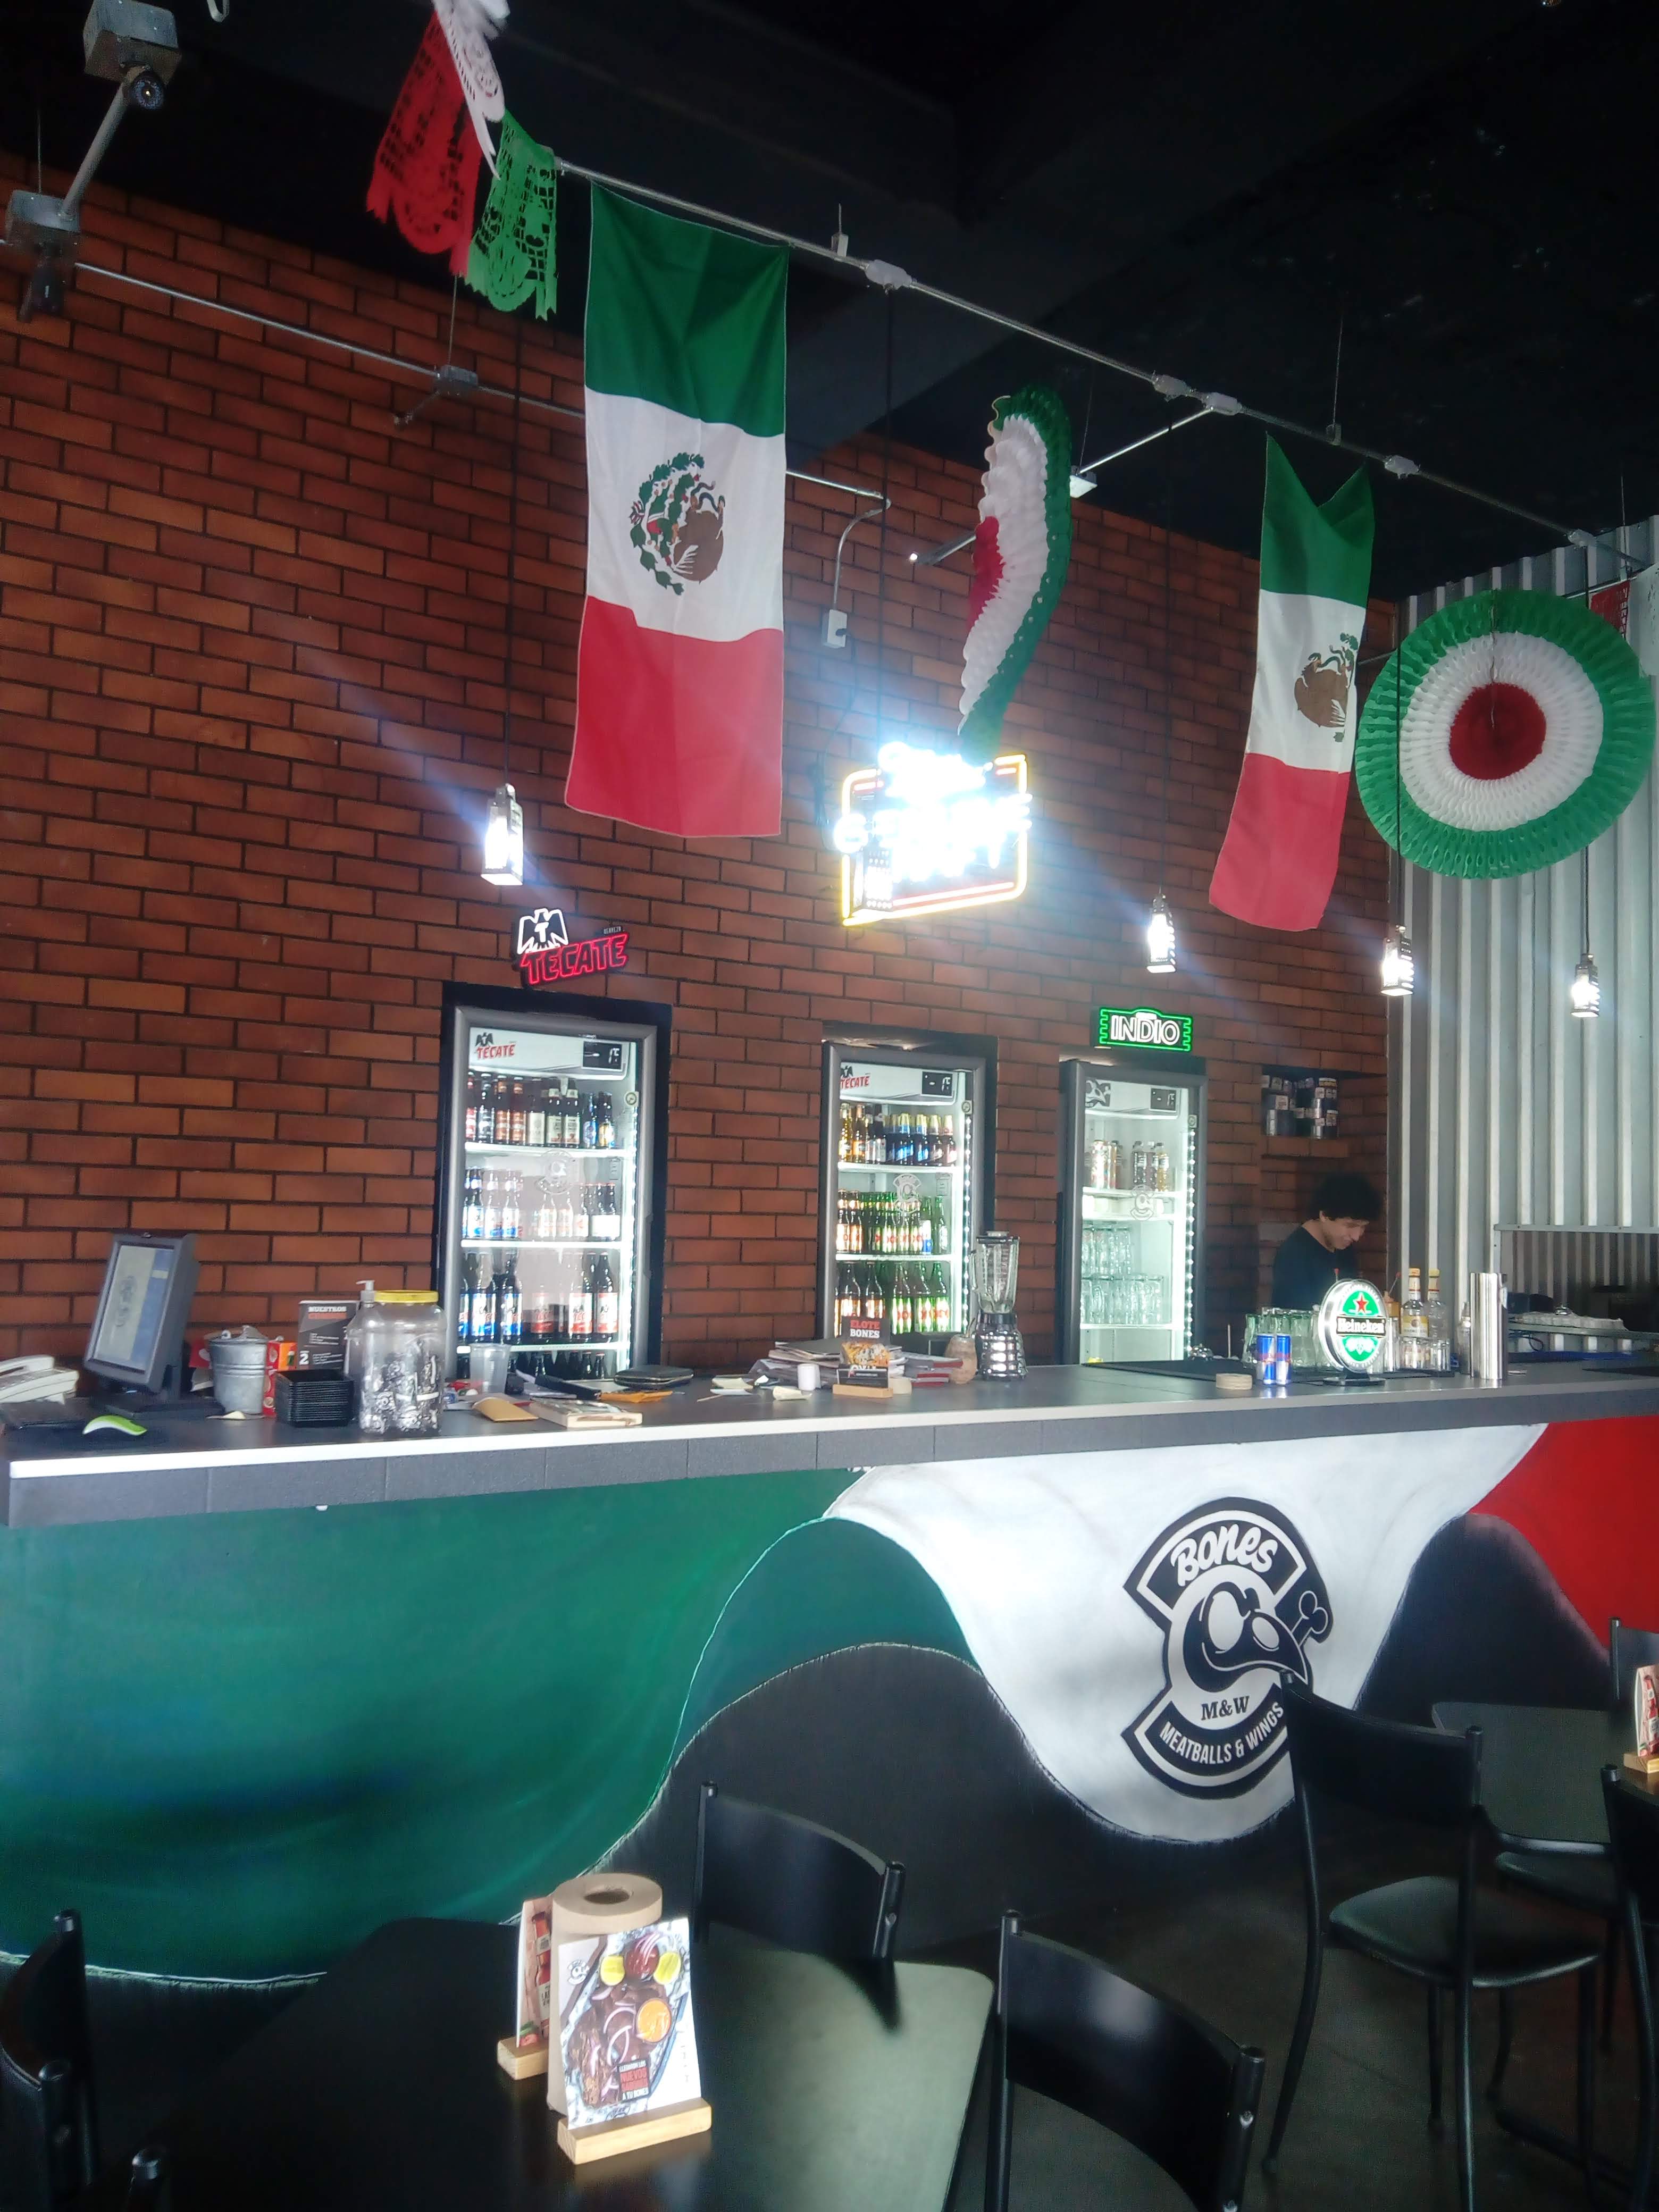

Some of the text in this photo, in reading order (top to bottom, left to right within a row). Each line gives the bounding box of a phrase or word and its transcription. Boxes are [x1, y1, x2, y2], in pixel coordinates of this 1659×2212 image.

[521, 934, 629, 984] TECATE
[1111, 1015, 1180, 1045] INDIO
[476, 1044, 516, 1060] TECATE
[840, 1076, 870, 1089] TECATE
[850, 1320, 881, 1329] ELOTE
[1337, 1317, 1385, 1334] Heineken
[850, 1329, 881, 1339] BONES
[299, 1353, 309, 1365] 2
[1170, 1523, 1278, 1587] Bones
[1201, 1695, 1251, 1721] M&W
[1159, 1701, 1284, 1765] MEATBALLS & WINGS
